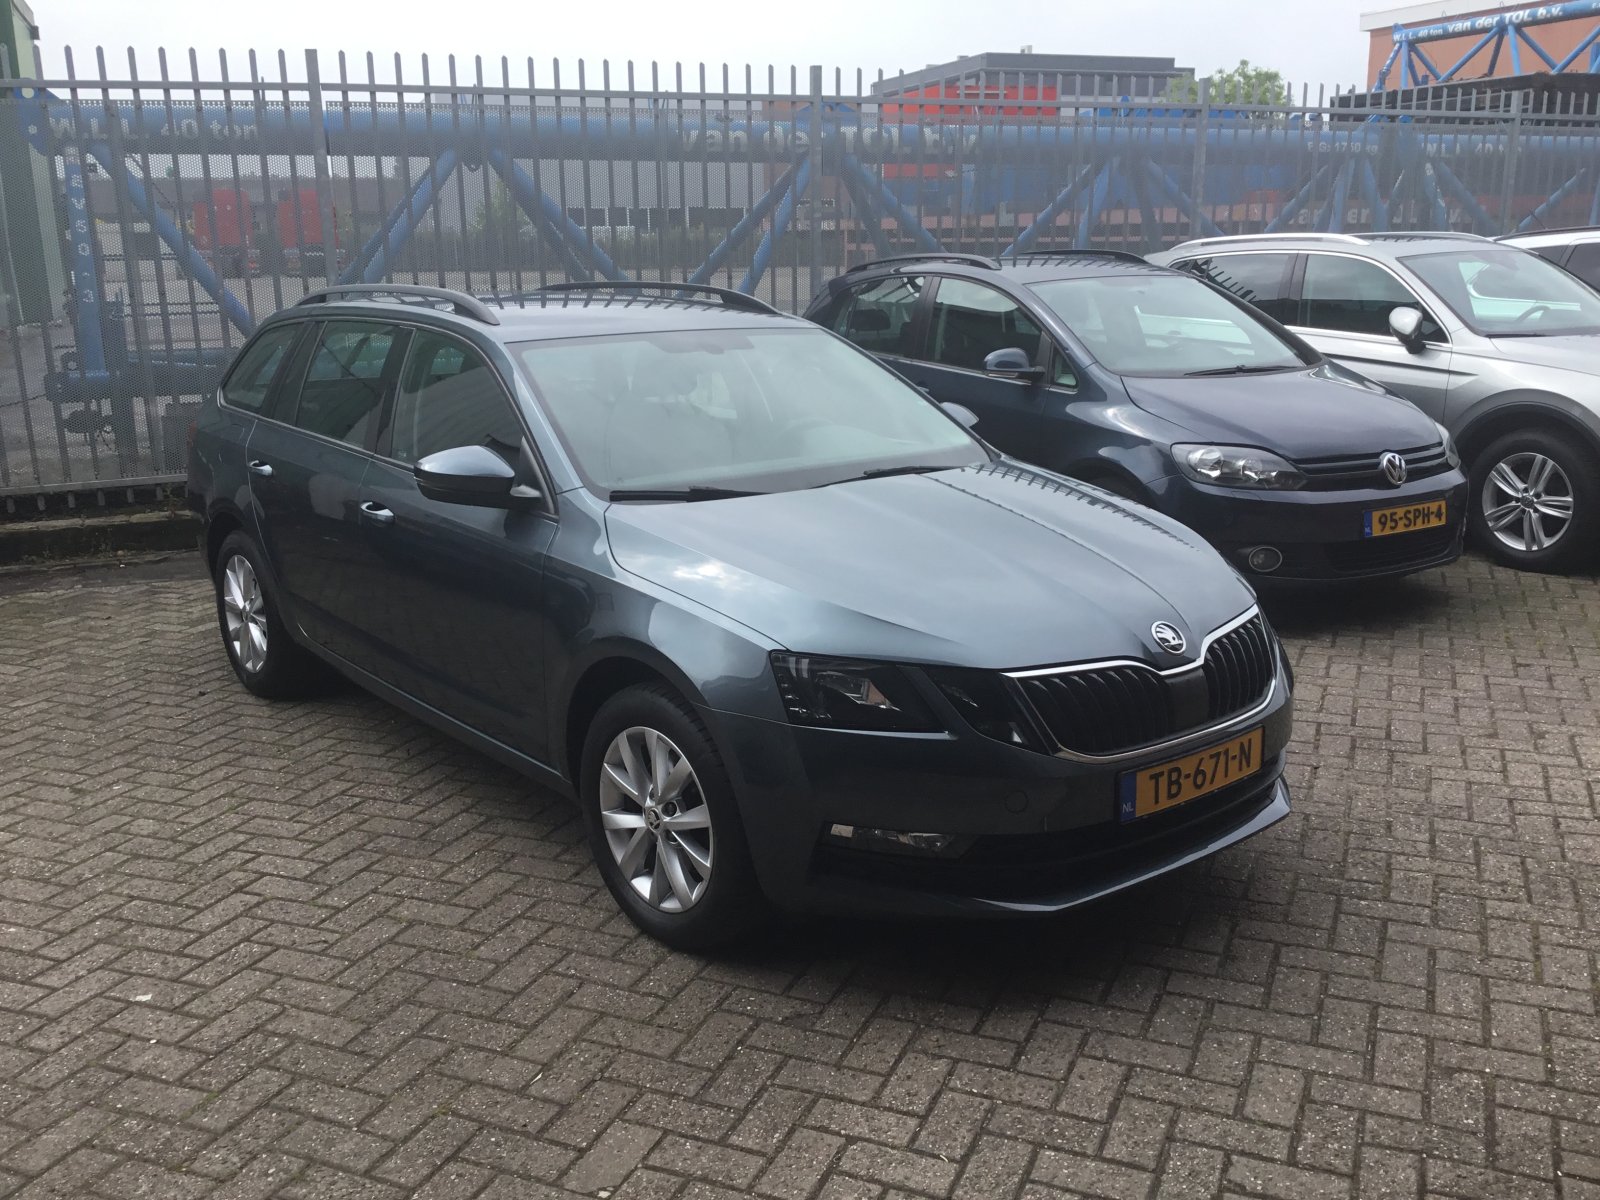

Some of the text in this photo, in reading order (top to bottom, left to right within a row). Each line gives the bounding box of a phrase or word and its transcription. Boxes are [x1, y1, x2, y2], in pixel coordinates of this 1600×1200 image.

[1448, 22, 1471, 34] van
[1475, 16, 1499, 28] der
[1503, 10, 1533, 25] TOL
[1537, 6, 1563, 19] b.v.
[678, 130, 748, 153] van
[762, 125, 827, 153] de
[1378, 503, 1445, 533] 95-SPH-4
[1149, 738, 1252, 805] TB-671-N
